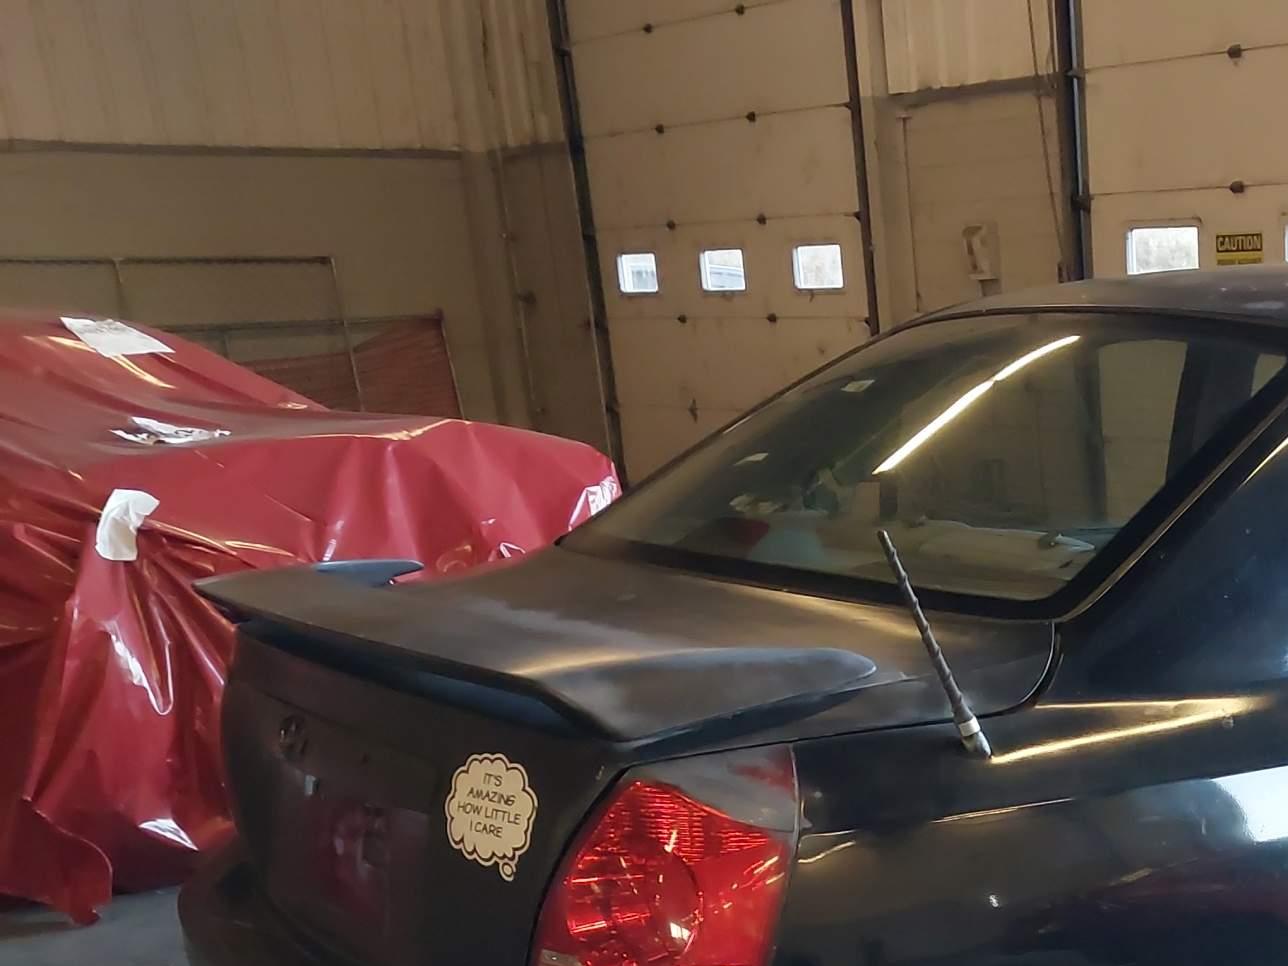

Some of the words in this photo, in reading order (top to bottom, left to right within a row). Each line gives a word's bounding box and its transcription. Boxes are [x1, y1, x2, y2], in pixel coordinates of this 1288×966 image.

[1217, 235, 1262, 251] CAUTION
[482, 772, 503, 787] IT'S
[467, 787, 515, 806] AMAZING
[457, 801, 482, 816] HOW
[484, 807, 521, 825] LITTLE
[474, 822, 503, 838] CARE
